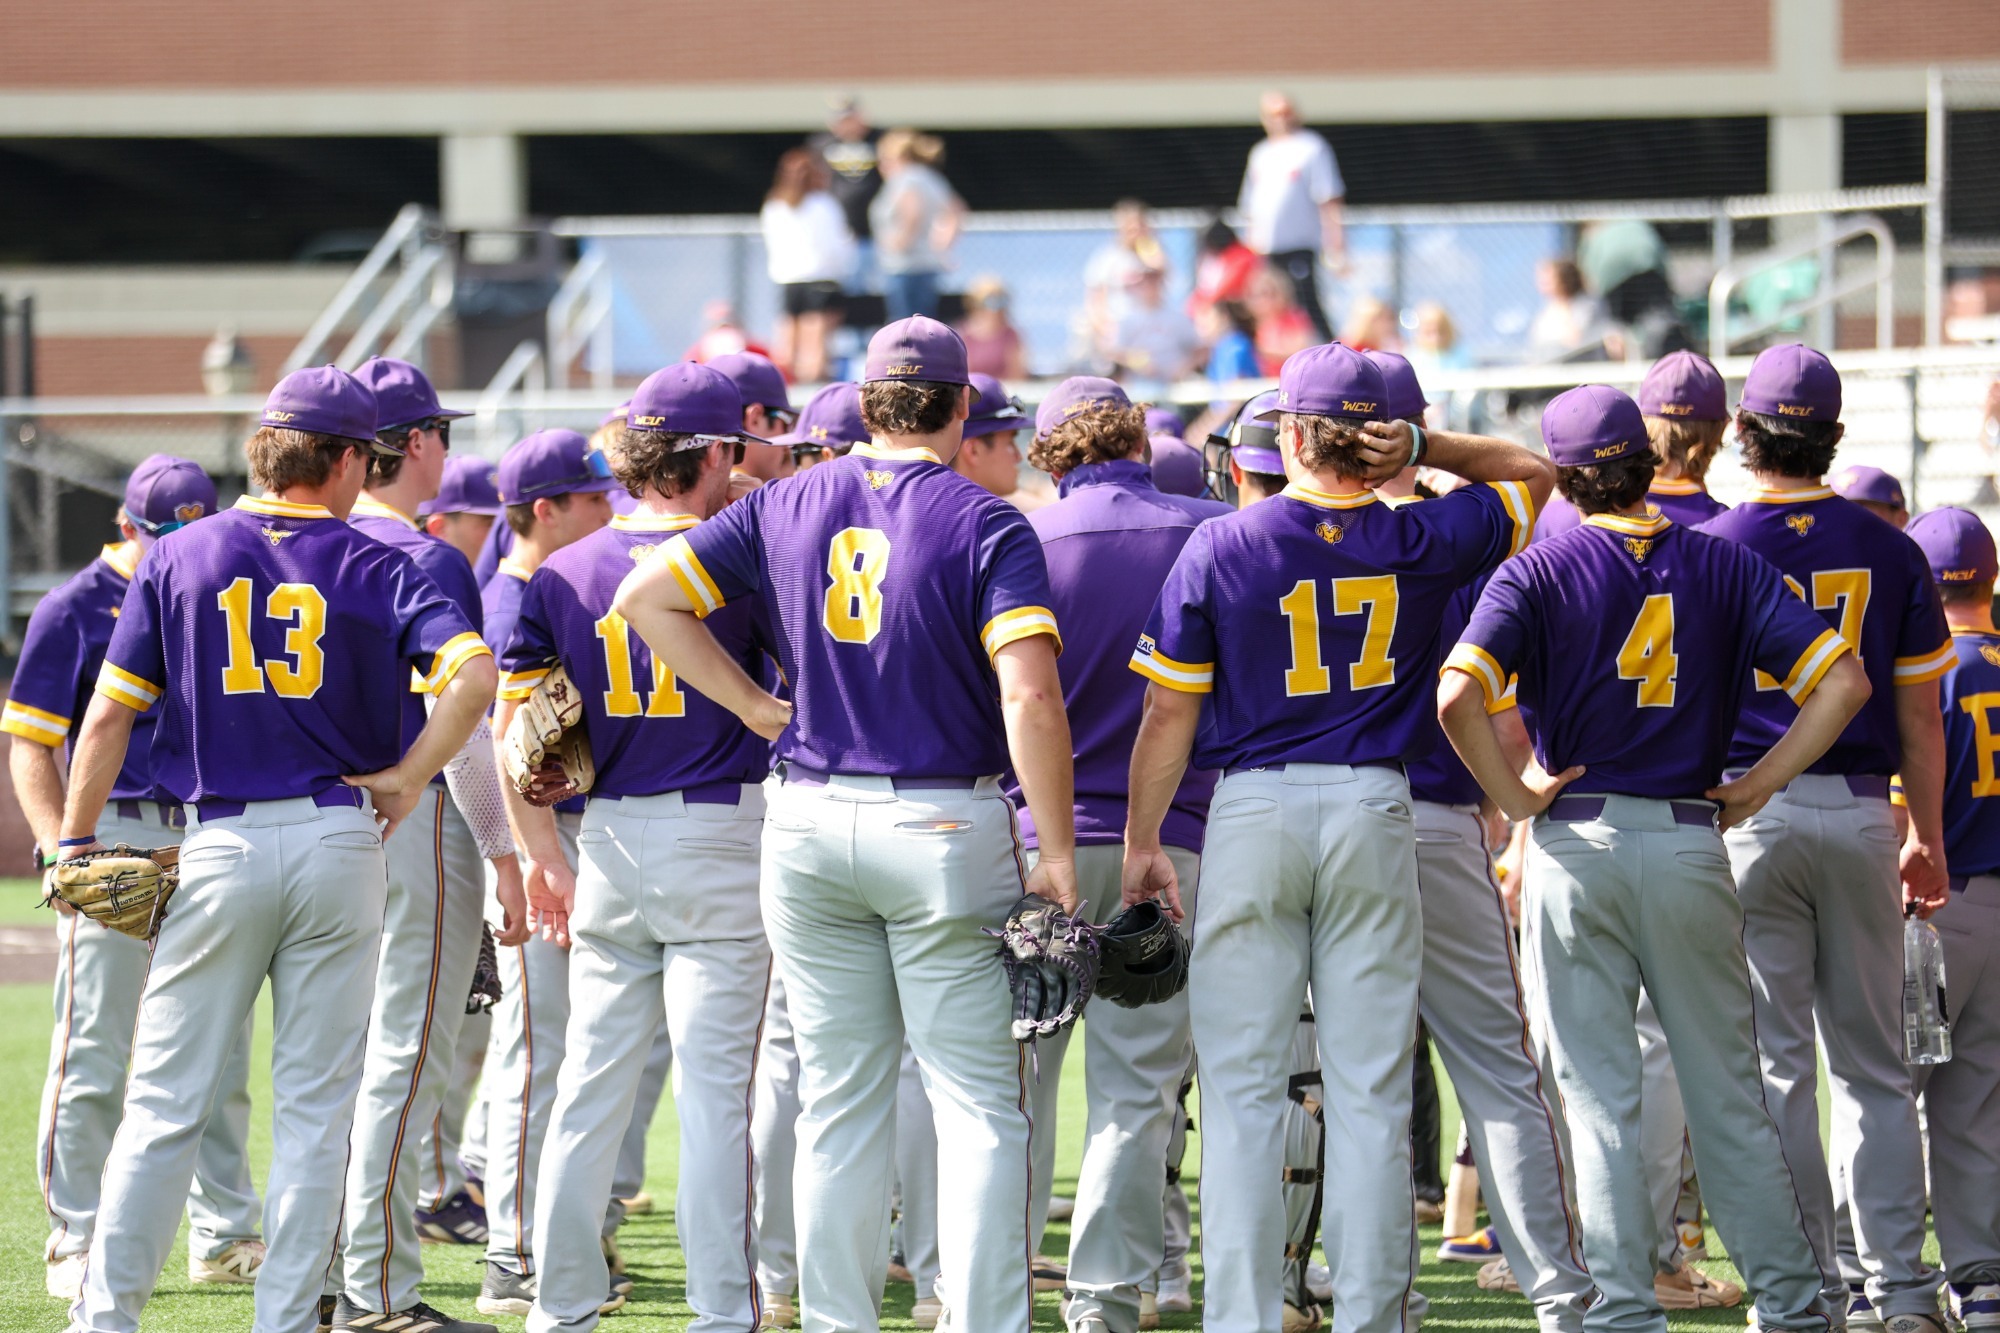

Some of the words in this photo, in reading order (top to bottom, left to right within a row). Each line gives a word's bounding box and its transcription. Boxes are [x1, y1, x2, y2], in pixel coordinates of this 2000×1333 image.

[885, 365, 923, 376] WCU
[1062, 399, 1097, 416] WCU
[1342, 400, 1377, 413] WCU
[1660, 403, 1694, 416] WCU
[1778, 403, 1814, 416] WCU
[265, 409, 295, 423] WCU
[633, 414, 665, 427] WCU
[1593, 441, 1628, 459] WCU
[1942, 568, 1977, 581] WCU
[823, 526, 891, 645] 8
[1279, 574, 1399, 697] 17
[1753, 568, 1871, 692] 7
[217, 576, 327, 700] 13
[1616, 593, 1679, 708] 4
